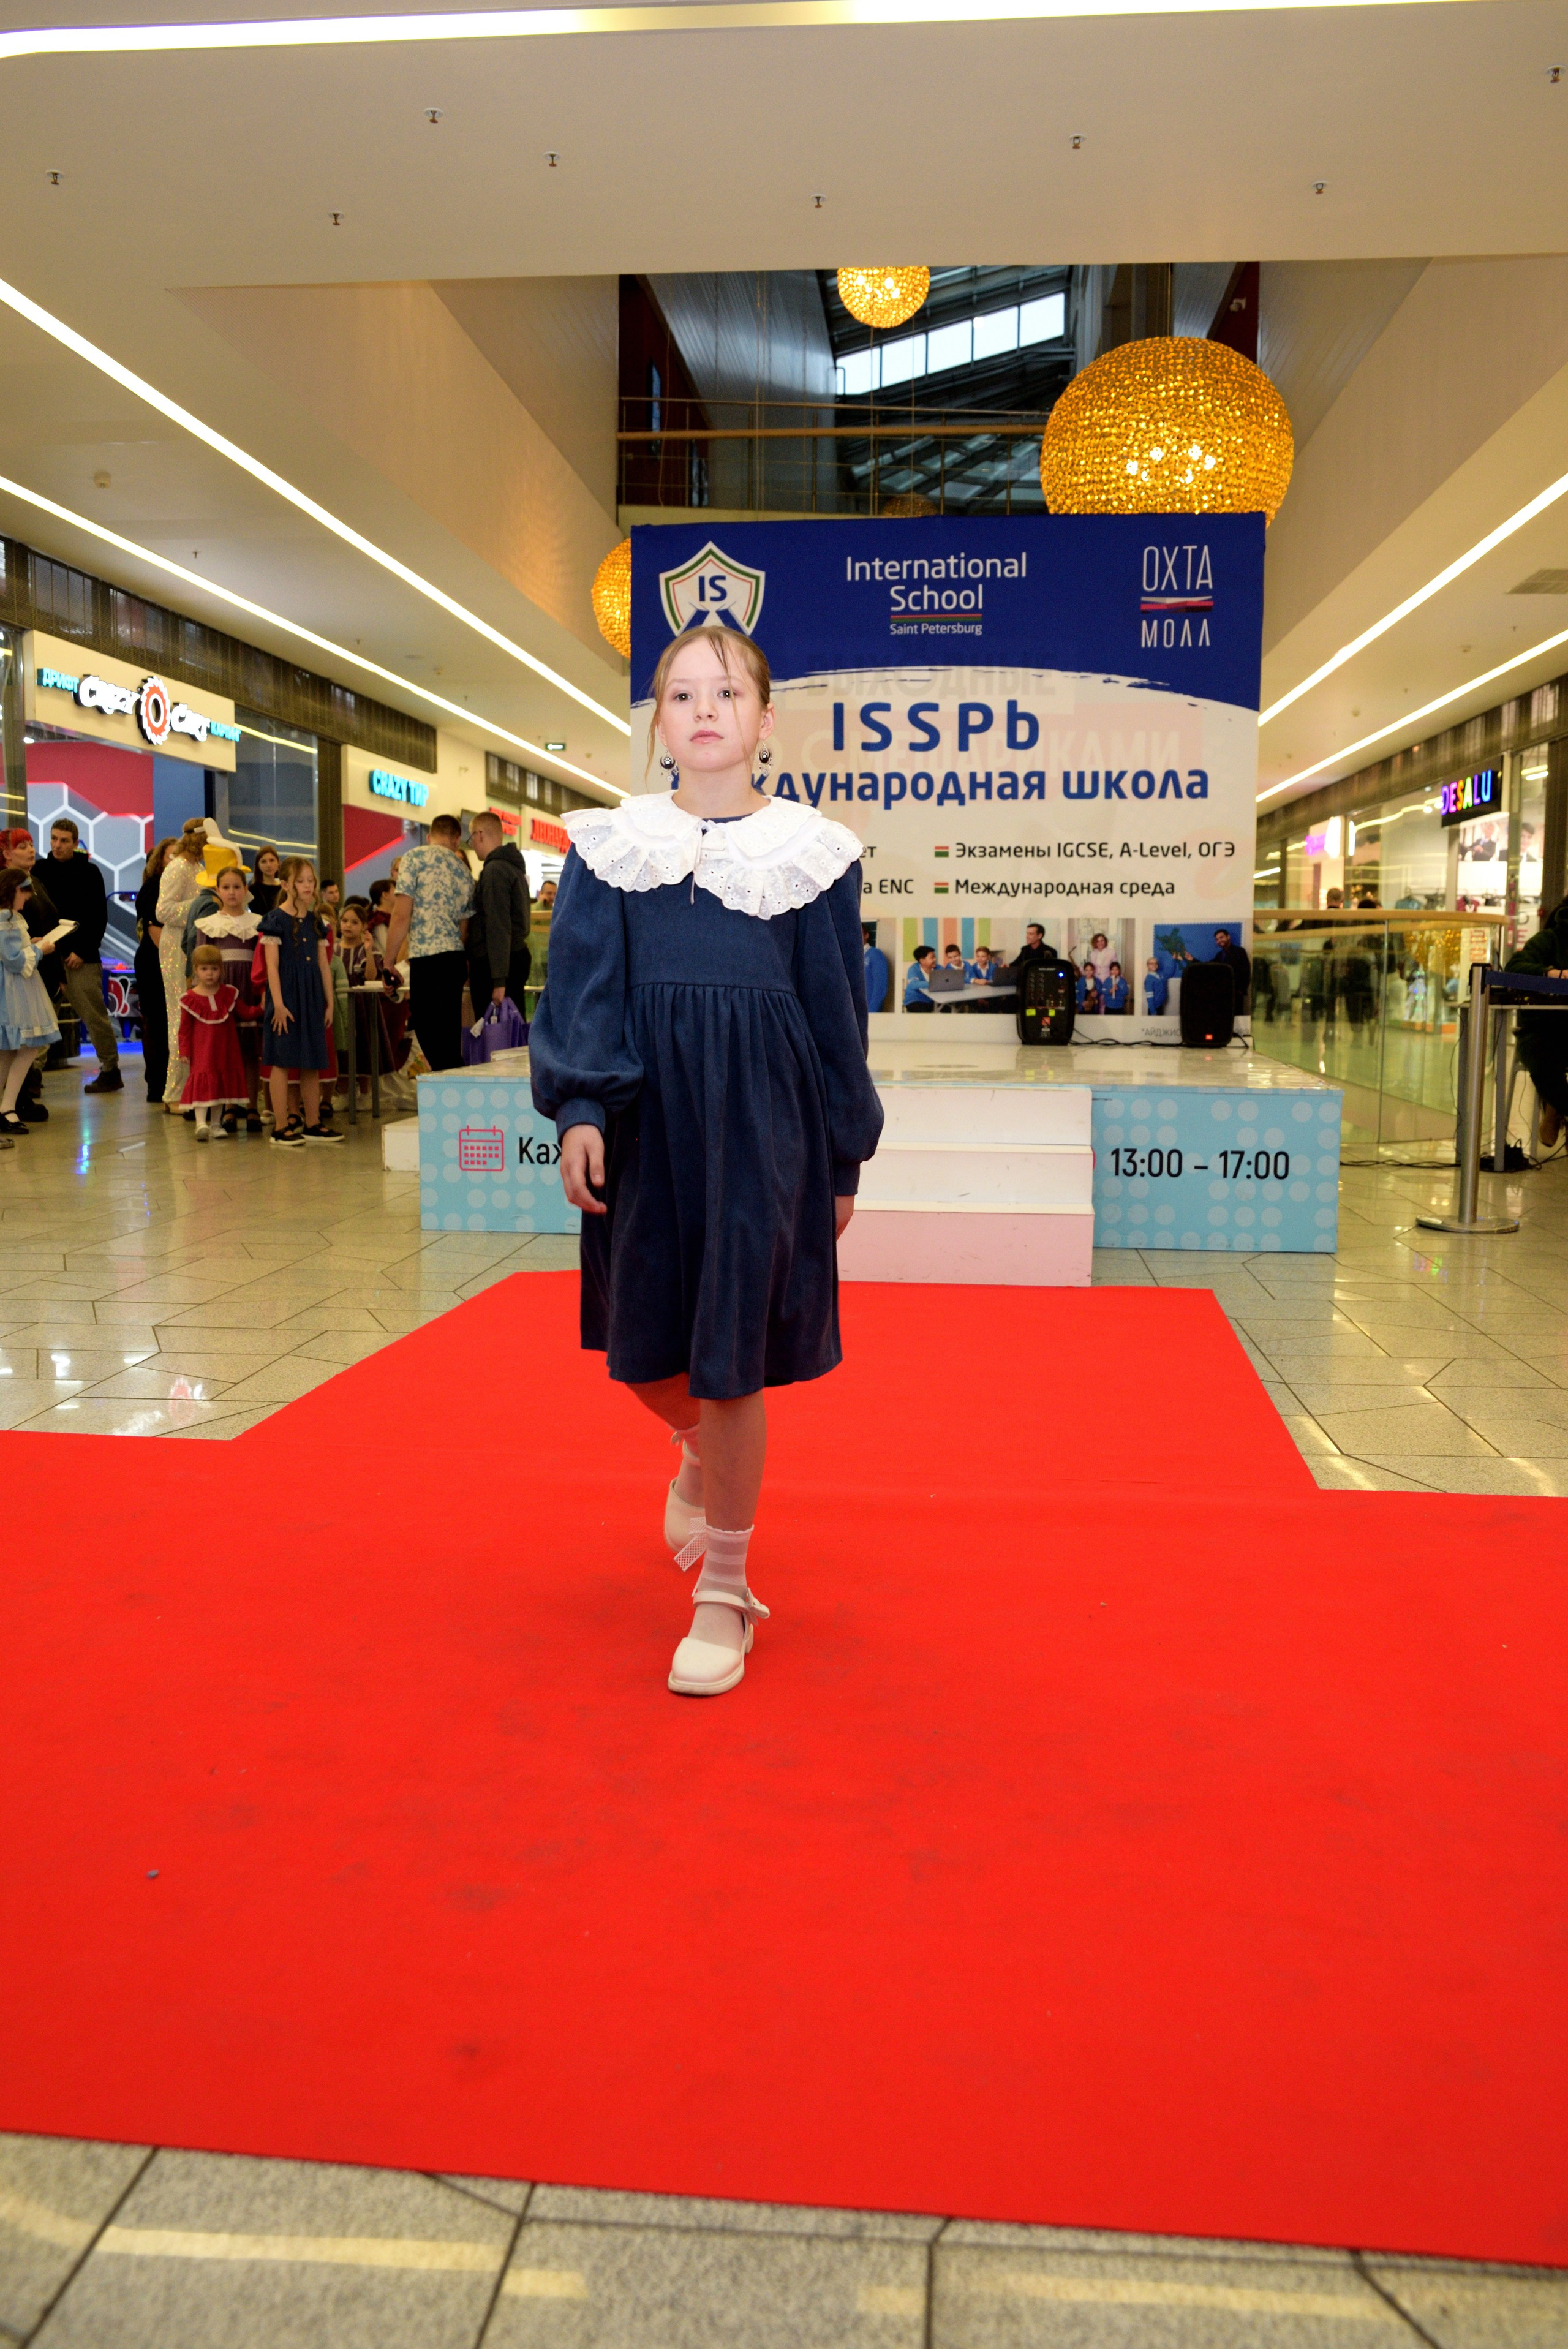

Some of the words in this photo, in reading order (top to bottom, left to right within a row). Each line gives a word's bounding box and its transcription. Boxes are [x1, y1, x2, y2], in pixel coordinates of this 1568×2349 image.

[846, 552, 1027, 581] International
[1142, 545, 1213, 592] ОХТА
[699, 575, 727, 602] IS
[890, 584, 982, 611] School
[890, 624, 918, 635] Saint
[921, 622, 982, 636] Petersburg
[43, 667, 79, 693] ДРИФТ
[833, 699, 1039, 752] ISSPb
[372, 768, 409, 802] CRAZY
[409, 780, 429, 807] ТИР
[1063, 769, 1208, 799] школа
[1441, 768, 1492, 815] DESALU
[956, 842, 1050, 858] Экзамены
[1057, 842, 1113, 859] IGCSE,
[1120, 842, 1192, 859] A-Level,
[1199, 842, 1235, 858] ОГЭ
[880, 879, 914, 894] ENC
[956, 879, 1113, 897] Международная
[1120, 882, 1175, 897] среда
[1110, 1148, 1183, 1177] 13:00
[1219, 1150, 1289, 1180] 17:00
